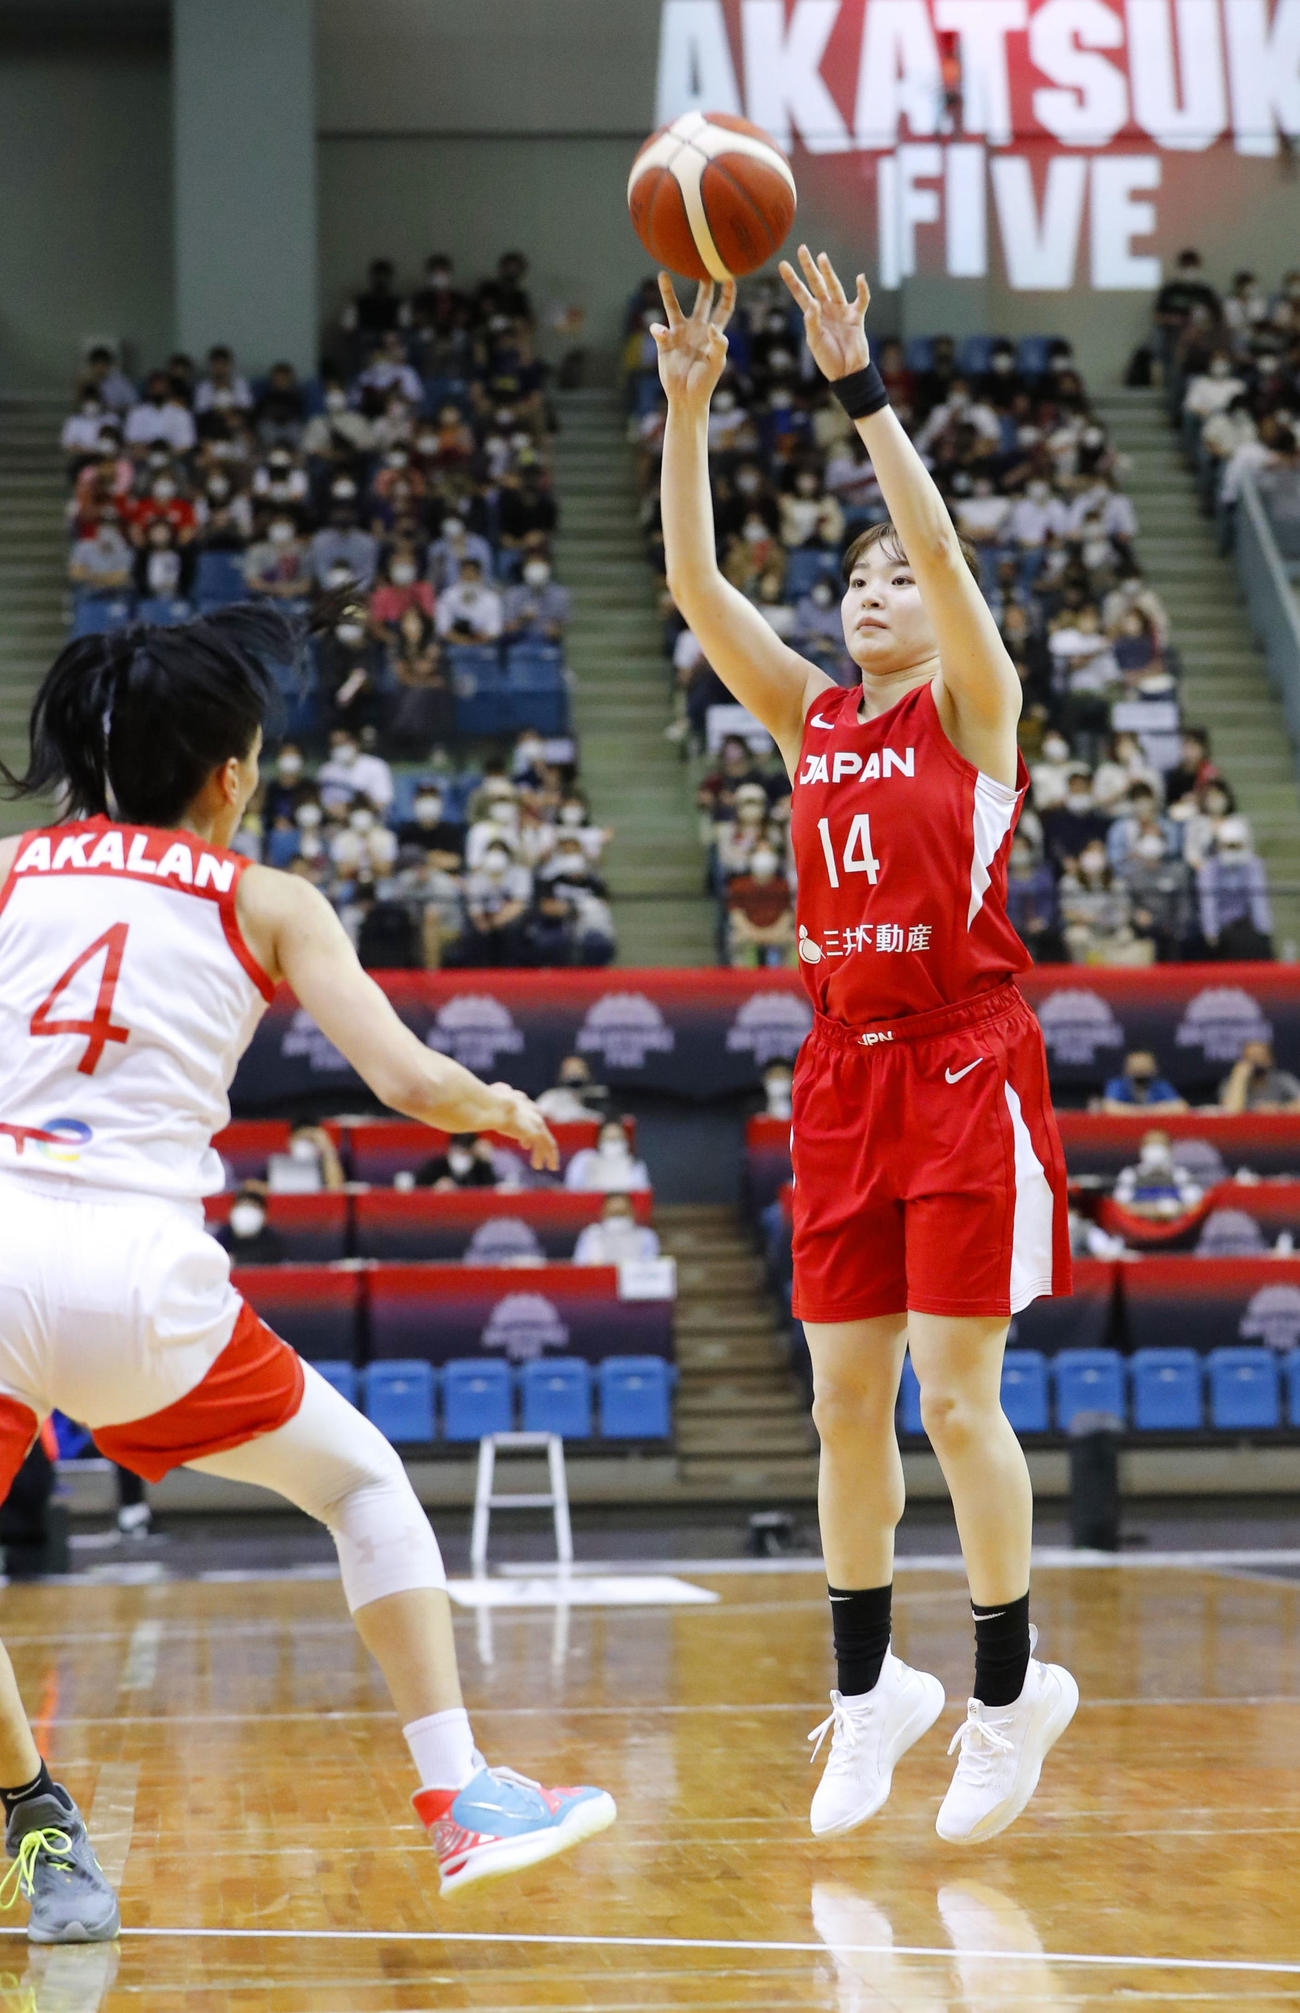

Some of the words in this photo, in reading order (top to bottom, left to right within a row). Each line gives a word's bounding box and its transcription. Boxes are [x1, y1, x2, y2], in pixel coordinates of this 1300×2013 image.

[877, 143, 1162, 291] FIVE
[799, 747, 916, 785] JAPAN
[14, 831, 236, 893] AKALAN
[816, 813, 881, 888] 14
[29, 922, 130, 1076] 4
[857, 1030, 895, 1047] JPN
